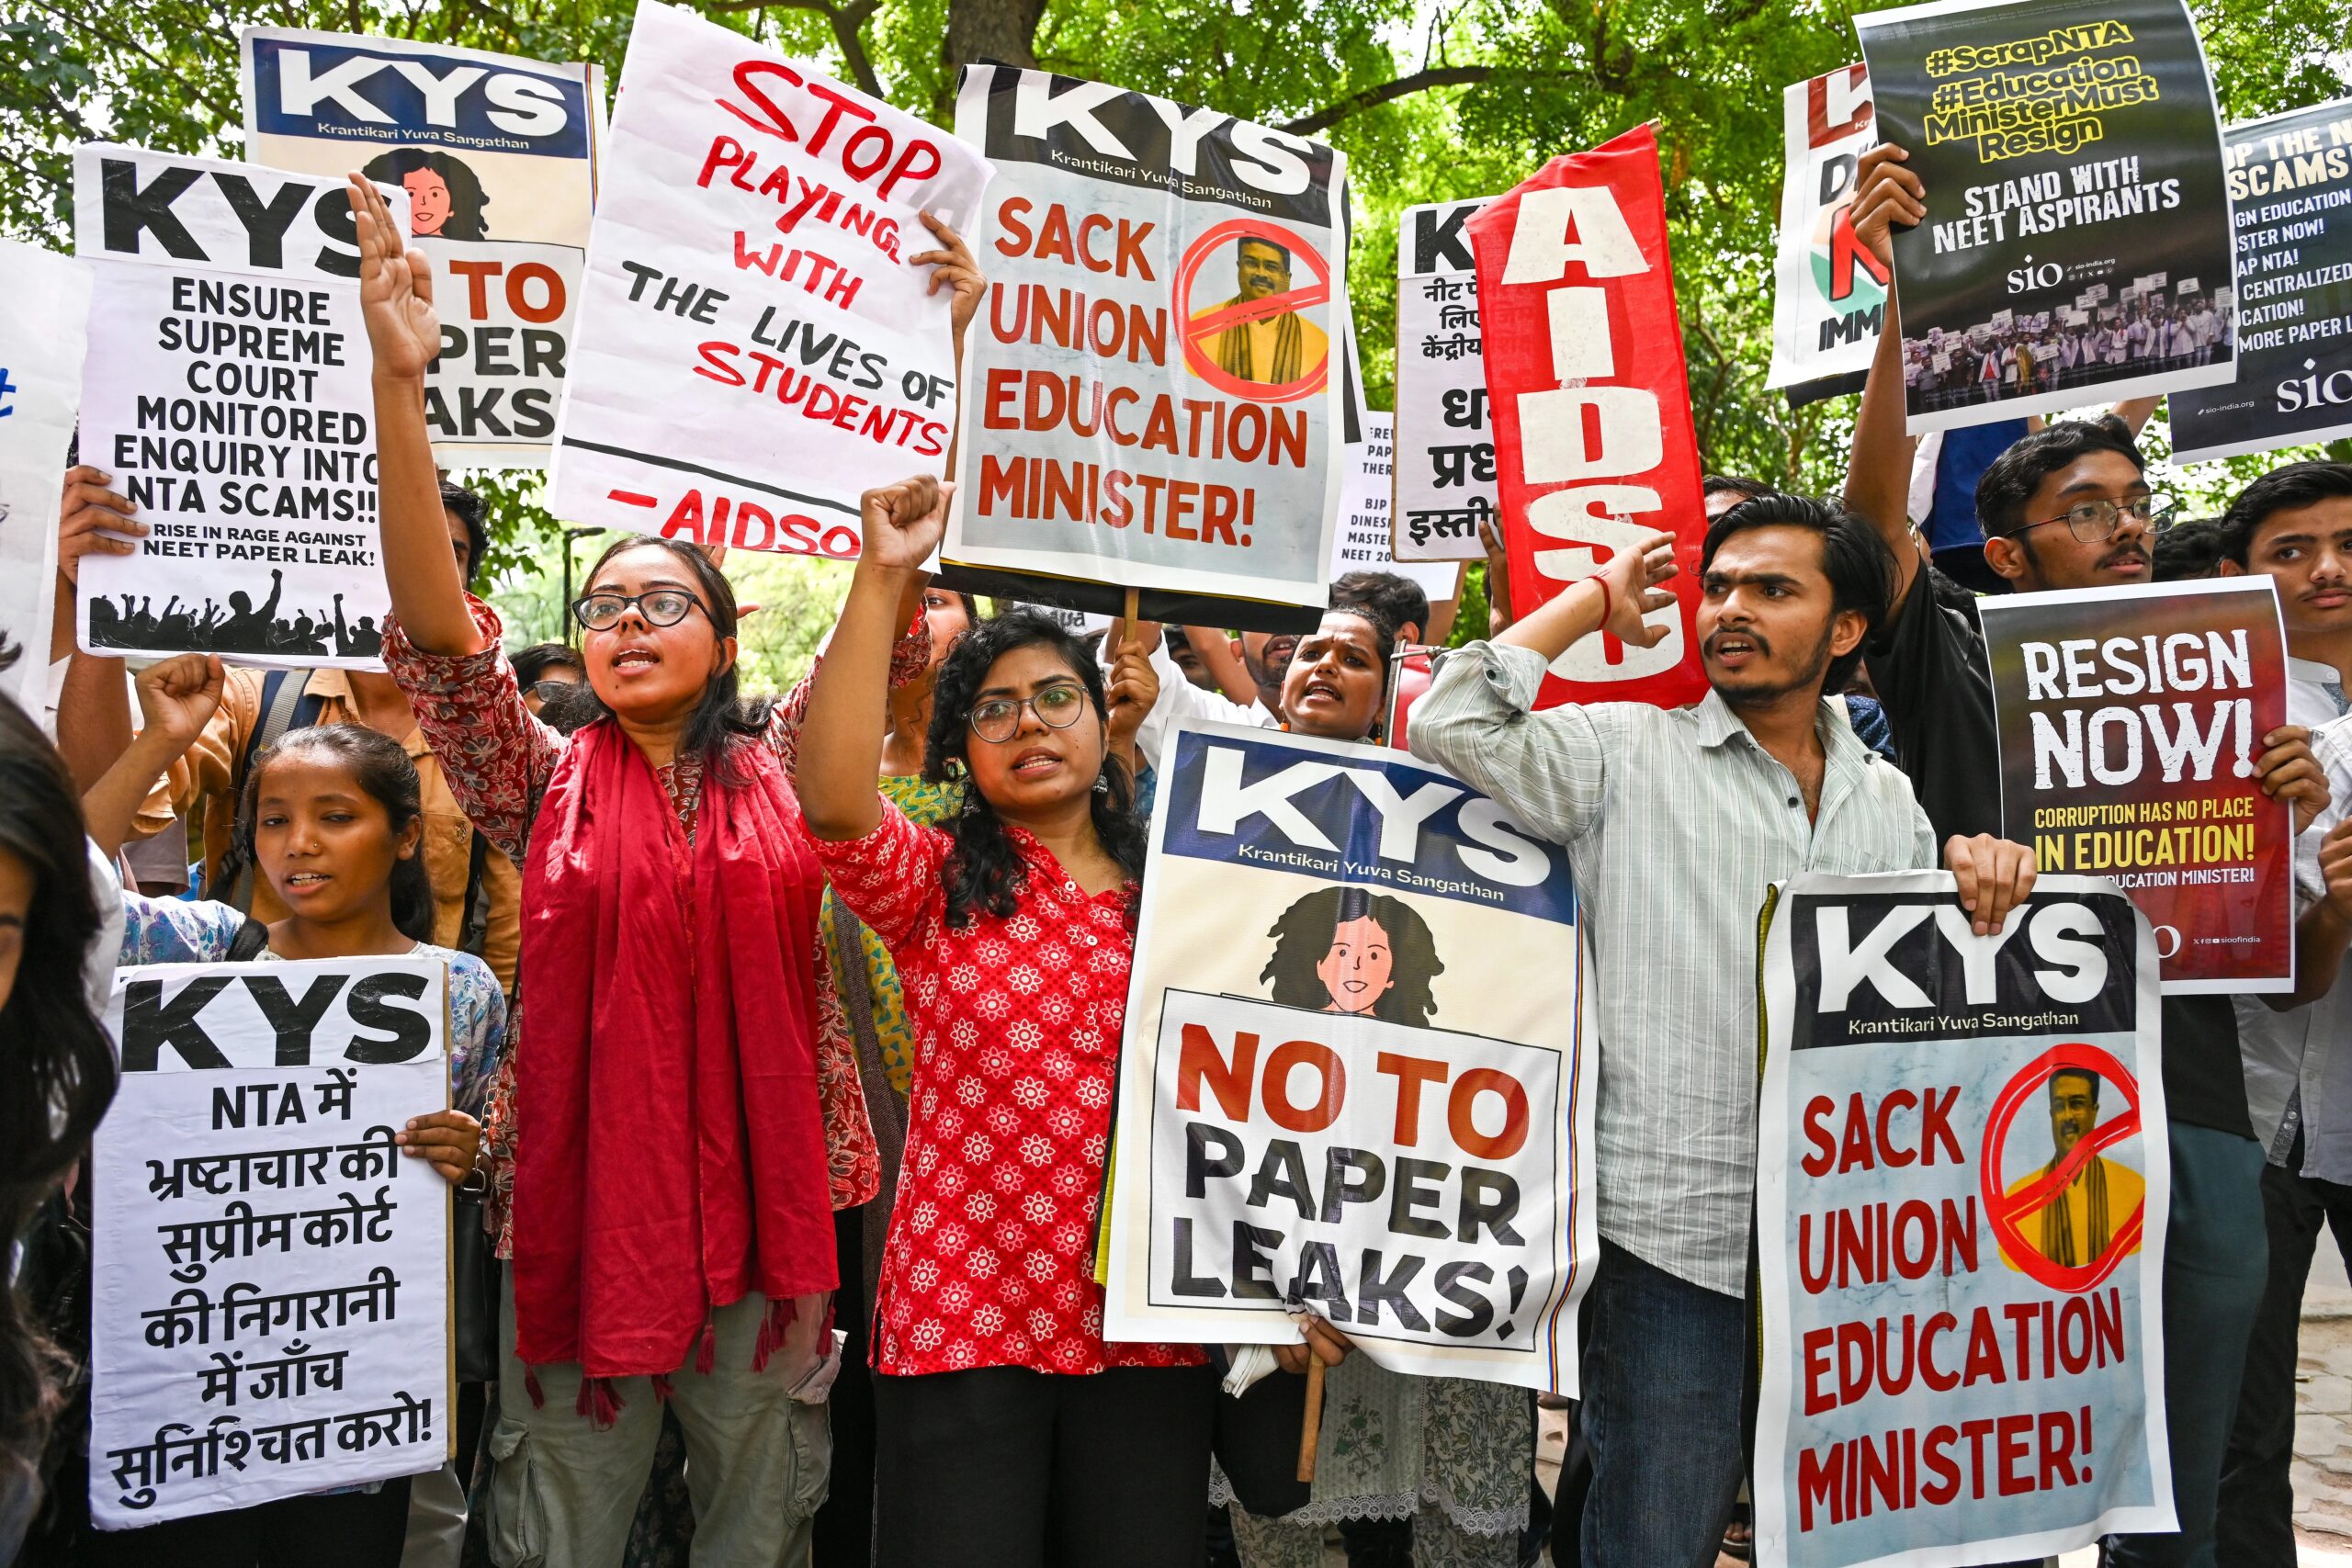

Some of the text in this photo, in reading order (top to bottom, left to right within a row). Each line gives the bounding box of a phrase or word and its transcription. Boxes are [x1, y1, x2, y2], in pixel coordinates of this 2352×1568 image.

[1926, 20, 2135, 78] #ScrapNTA
[278, 48, 568, 137] KYS
[1924, 75, 2160, 145] MinisterMust
[1932, 55, 2142, 115] #Education
[317, 122, 530, 150] Krantikari Yuva Sangathan
[714, 60, 942, 203] STOP
[1014, 69, 1314, 196] KYS
[1977, 116, 2103, 164] Resign
[2261, 126, 2324, 161] THE
[696, 135, 901, 265] PLAYING
[1050, 148, 1272, 209] Krantikari Yuva Sangathan
[1964, 155, 2140, 218] STAND WITH
[2260, 188, 2352, 223] EDUCATION
[101, 158, 392, 278] KYS
[994, 197, 1156, 282] SACK
[1932, 210, 2007, 254] NEET
[2018, 178, 2181, 238] ASPIRANTS
[2282, 218, 2324, 243] NOW!
[449, 259, 567, 323] TO
[733, 231, 864, 310] WITH
[1423, 277, 1464, 302] नीट
[2007, 254, 2064, 294] sio
[2262, 248, 2300, 272] NTA!
[173, 276, 330, 326] ENSURE
[989, 282, 1168, 367] UNION
[159, 317, 345, 367] SUPREME
[426, 324, 566, 378] PER
[622, 260, 955, 410] THE LIVES OF
[2238, 328, 2285, 354] MORE
[2289, 317, 2342, 344] PAPER
[187, 360, 318, 403] COURT
[692, 341, 949, 457] STUDENTS
[2205, 400, 2255, 414] sio-india.org
[137, 395, 367, 446] MONITORED
[983, 367, 1307, 468] EDUCATION
[114, 434, 291, 479] ENQUIRY
[128, 475, 206, 513] NTA
[978, 455, 1256, 548] MINISTER!
[1365, 498, 1387, 511] BJP
[143, 539, 376, 567] NEET PAPER LEAK!
[153, 524, 367, 547] RISE IN RAGE AGAINST
[1341, 548, 1372, 561] NEET
[2019, 628, 2253, 701] RESIGN
[2030, 698, 2254, 790] NOW!
[1196, 745, 1552, 887] KYS
[2034, 796, 2255, 829] CORRUPTION HAS NO PLACE
[1238, 843, 1505, 903] Krantikari Yuva Sangathan
[2035, 823, 2255, 873] IN EDUCATION!
[2104, 867, 2255, 889] UCATION MINISTER!
[1815, 902, 2108, 1013] KYS
[120, 972, 432, 1073] KYS
[1848, 1011, 2079, 1036] Krantikari Yuva Sangathan
[212, 1067, 357, 1131] NTA में
[1176, 1022, 1530, 1161] NO TO
[145, 1124, 399, 1202] भ्रष्टाचार की
[1801, 1086, 1964, 1178] SACK
[1184, 1121, 1526, 1247] PAPER
[158, 1185, 397, 1284] सुप्रीम कोर्ट
[1798, 1195, 1978, 1295] UNION
[141, 1266, 401, 1349] की निगरानी
[1170, 1216, 1530, 1342] LEAKS!
[197, 1337, 348, 1406] में जाँच
[1803, 1287, 2125, 1416] EDUCATION
[107, 1391, 433, 1509] सुनिश्चित करो!
[1797, 1404, 2093, 1533] MINISTER!
